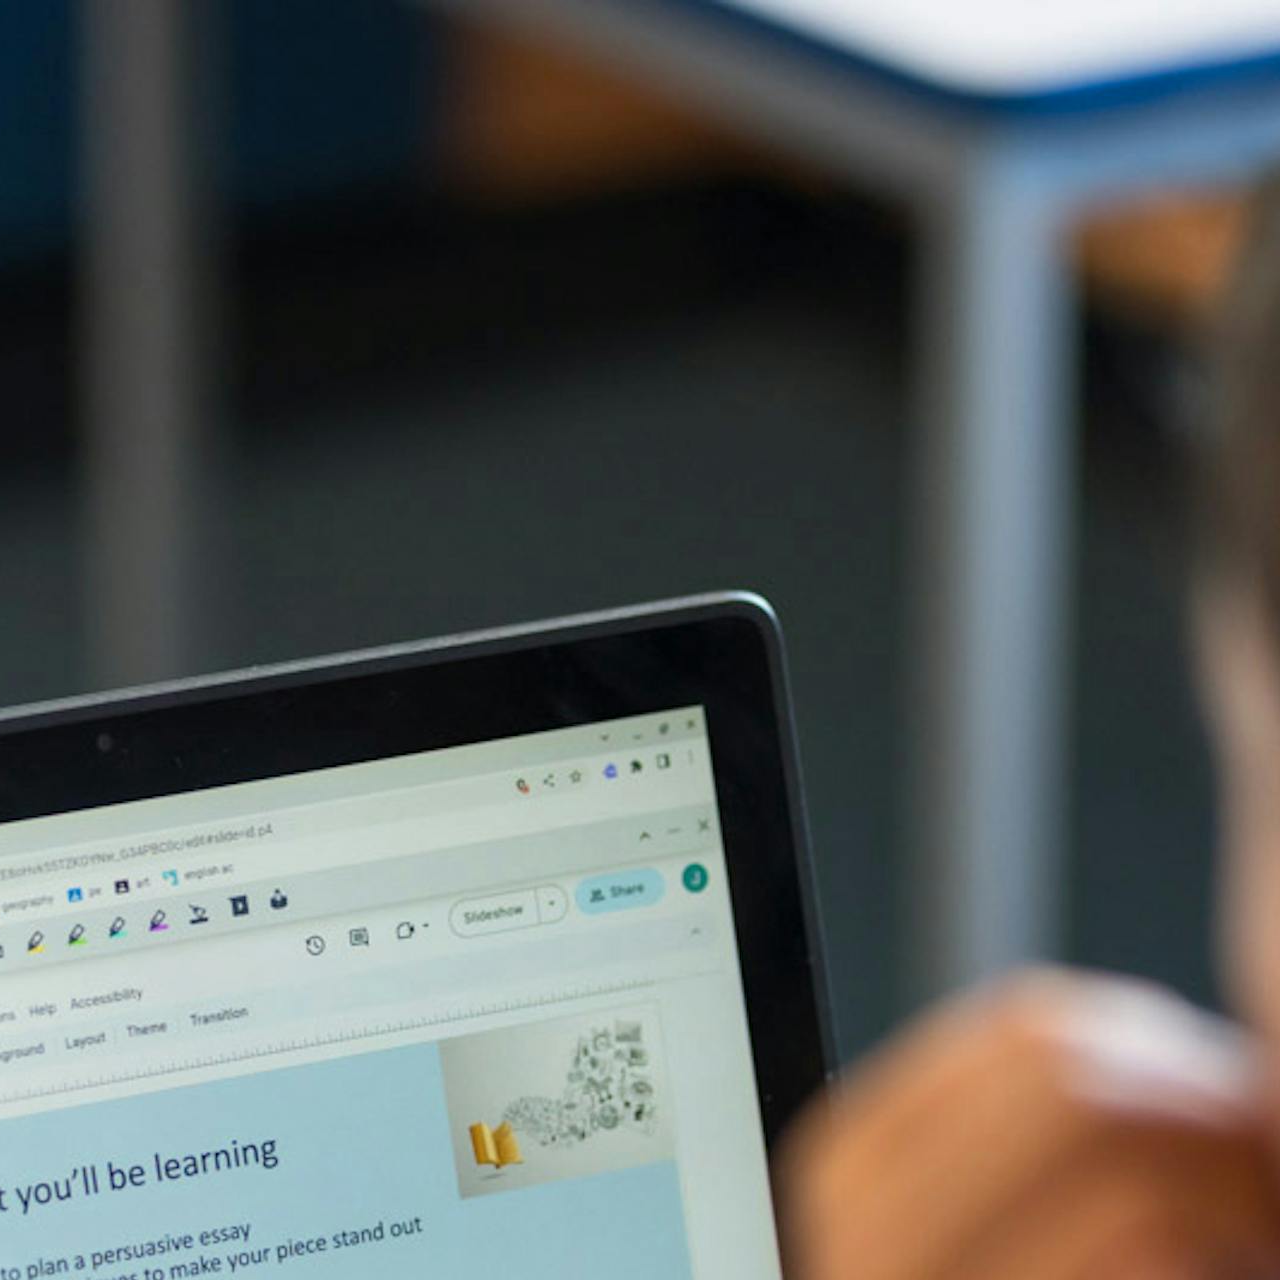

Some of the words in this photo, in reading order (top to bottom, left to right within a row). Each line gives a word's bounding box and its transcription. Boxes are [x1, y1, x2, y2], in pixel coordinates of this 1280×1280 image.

[610, 881, 644, 900] Share
[463, 904, 524, 925] Slideshow
[29, 1001, 58, 1018] Help
[70, 987, 143, 1010] Accessibility
[64, 1031, 106, 1051] Layout
[126, 1020, 168, 1037] Theme
[189, 1006, 249, 1027] Transition
[107, 1160, 147, 1193] be
[153, 1136, 280, 1182] learning
[73, 1254, 87, 1271] a
[90, 1230, 194, 1270] persuasive
[198, 1222, 252, 1247] essay
[226, 1248, 273, 1274] your
[275, 1232, 328, 1263] piece
[331, 1220, 385, 1249] stand
[389, 1215, 424, 1238] out
